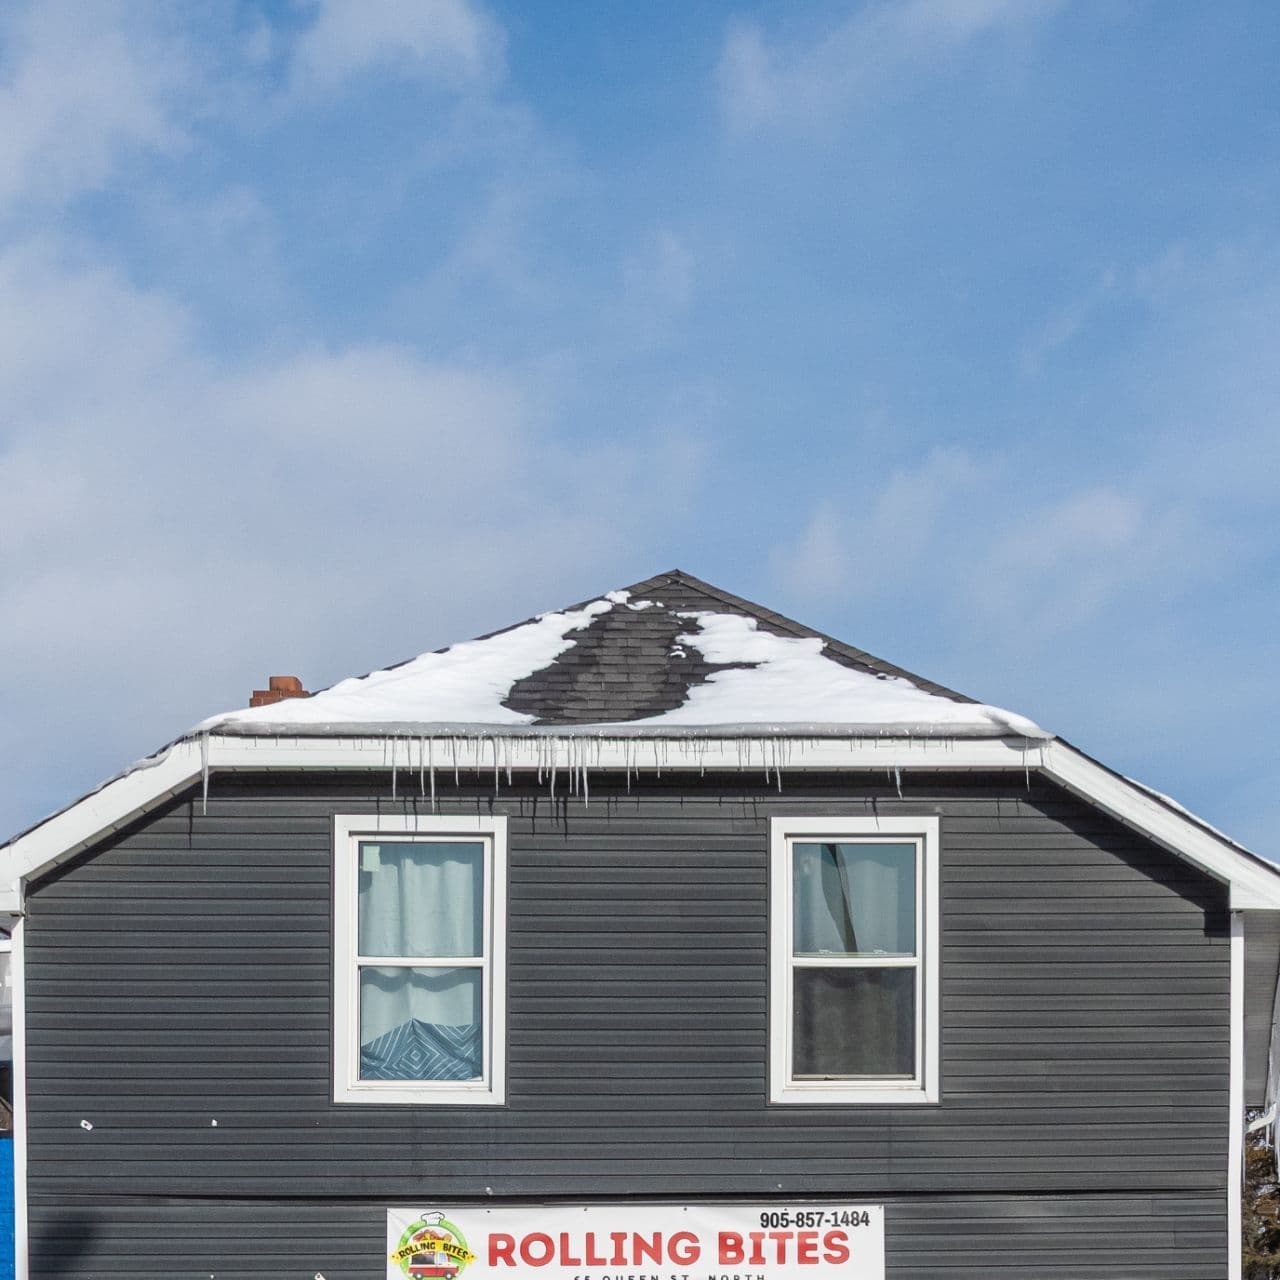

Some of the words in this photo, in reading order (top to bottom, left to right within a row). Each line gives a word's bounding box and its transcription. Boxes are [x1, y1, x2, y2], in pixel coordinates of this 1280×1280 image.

[760, 1210, 870, 1230] 905-857-1484
[398, 1242, 436, 1259] ROLLING
[443, 1243, 469, 1259] BITES
[488, 1231, 701, 1267] ROLLING
[718, 1230, 850, 1265] BITES
